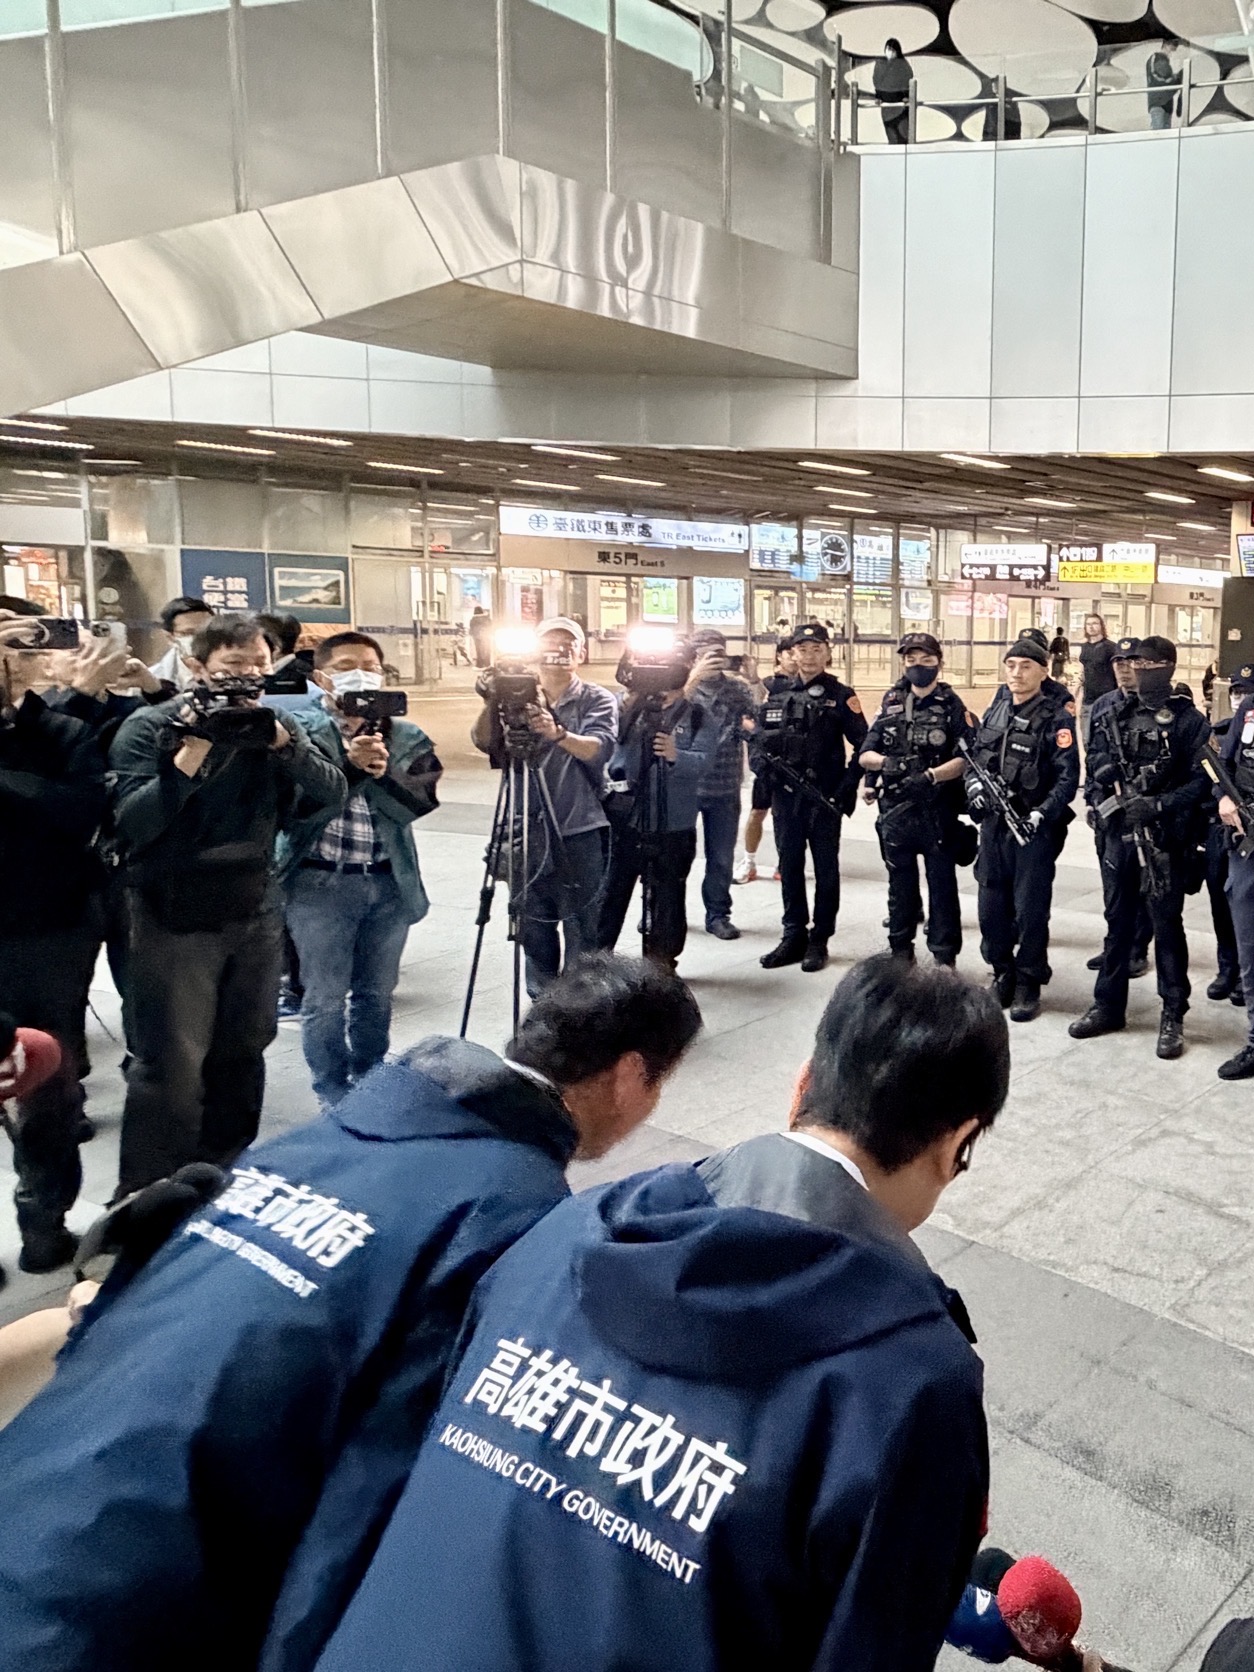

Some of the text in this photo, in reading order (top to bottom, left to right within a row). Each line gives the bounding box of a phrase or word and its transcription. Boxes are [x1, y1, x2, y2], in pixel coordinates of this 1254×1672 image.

[553, 516, 652, 538] 臺鐵東售票處
[661, 532, 726, 543] TR East Tickets
[597, 551, 639, 566] 東5門
[465, 1337, 748, 1532] 高雄市政府
[439, 1424, 702, 1585] KAOHSIUNG CITY GOVERNMENT
